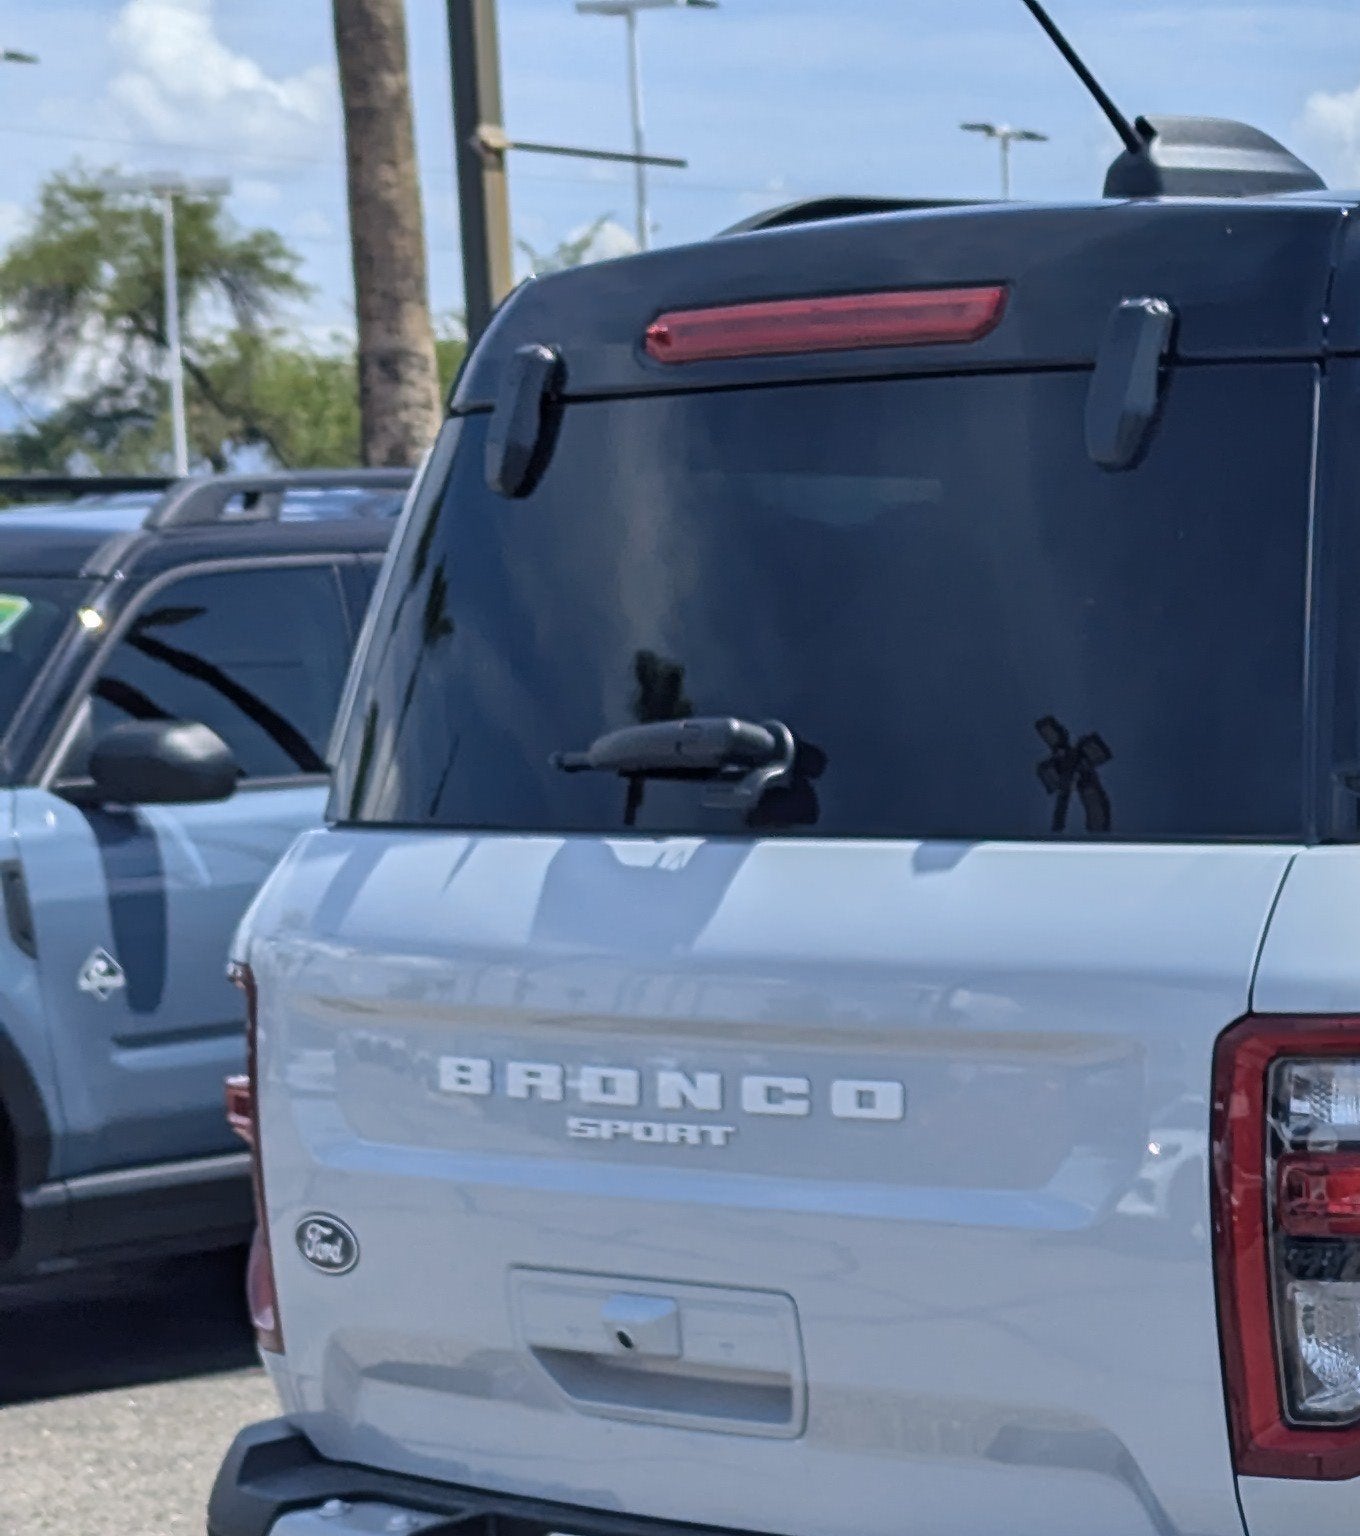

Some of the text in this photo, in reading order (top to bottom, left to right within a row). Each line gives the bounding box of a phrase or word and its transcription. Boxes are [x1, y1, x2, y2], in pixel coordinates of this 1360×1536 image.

[438, 1056, 905, 1121] BRONCO
[566, 1116, 736, 1146] SPORT
[305, 1222, 344, 1264] Ford
